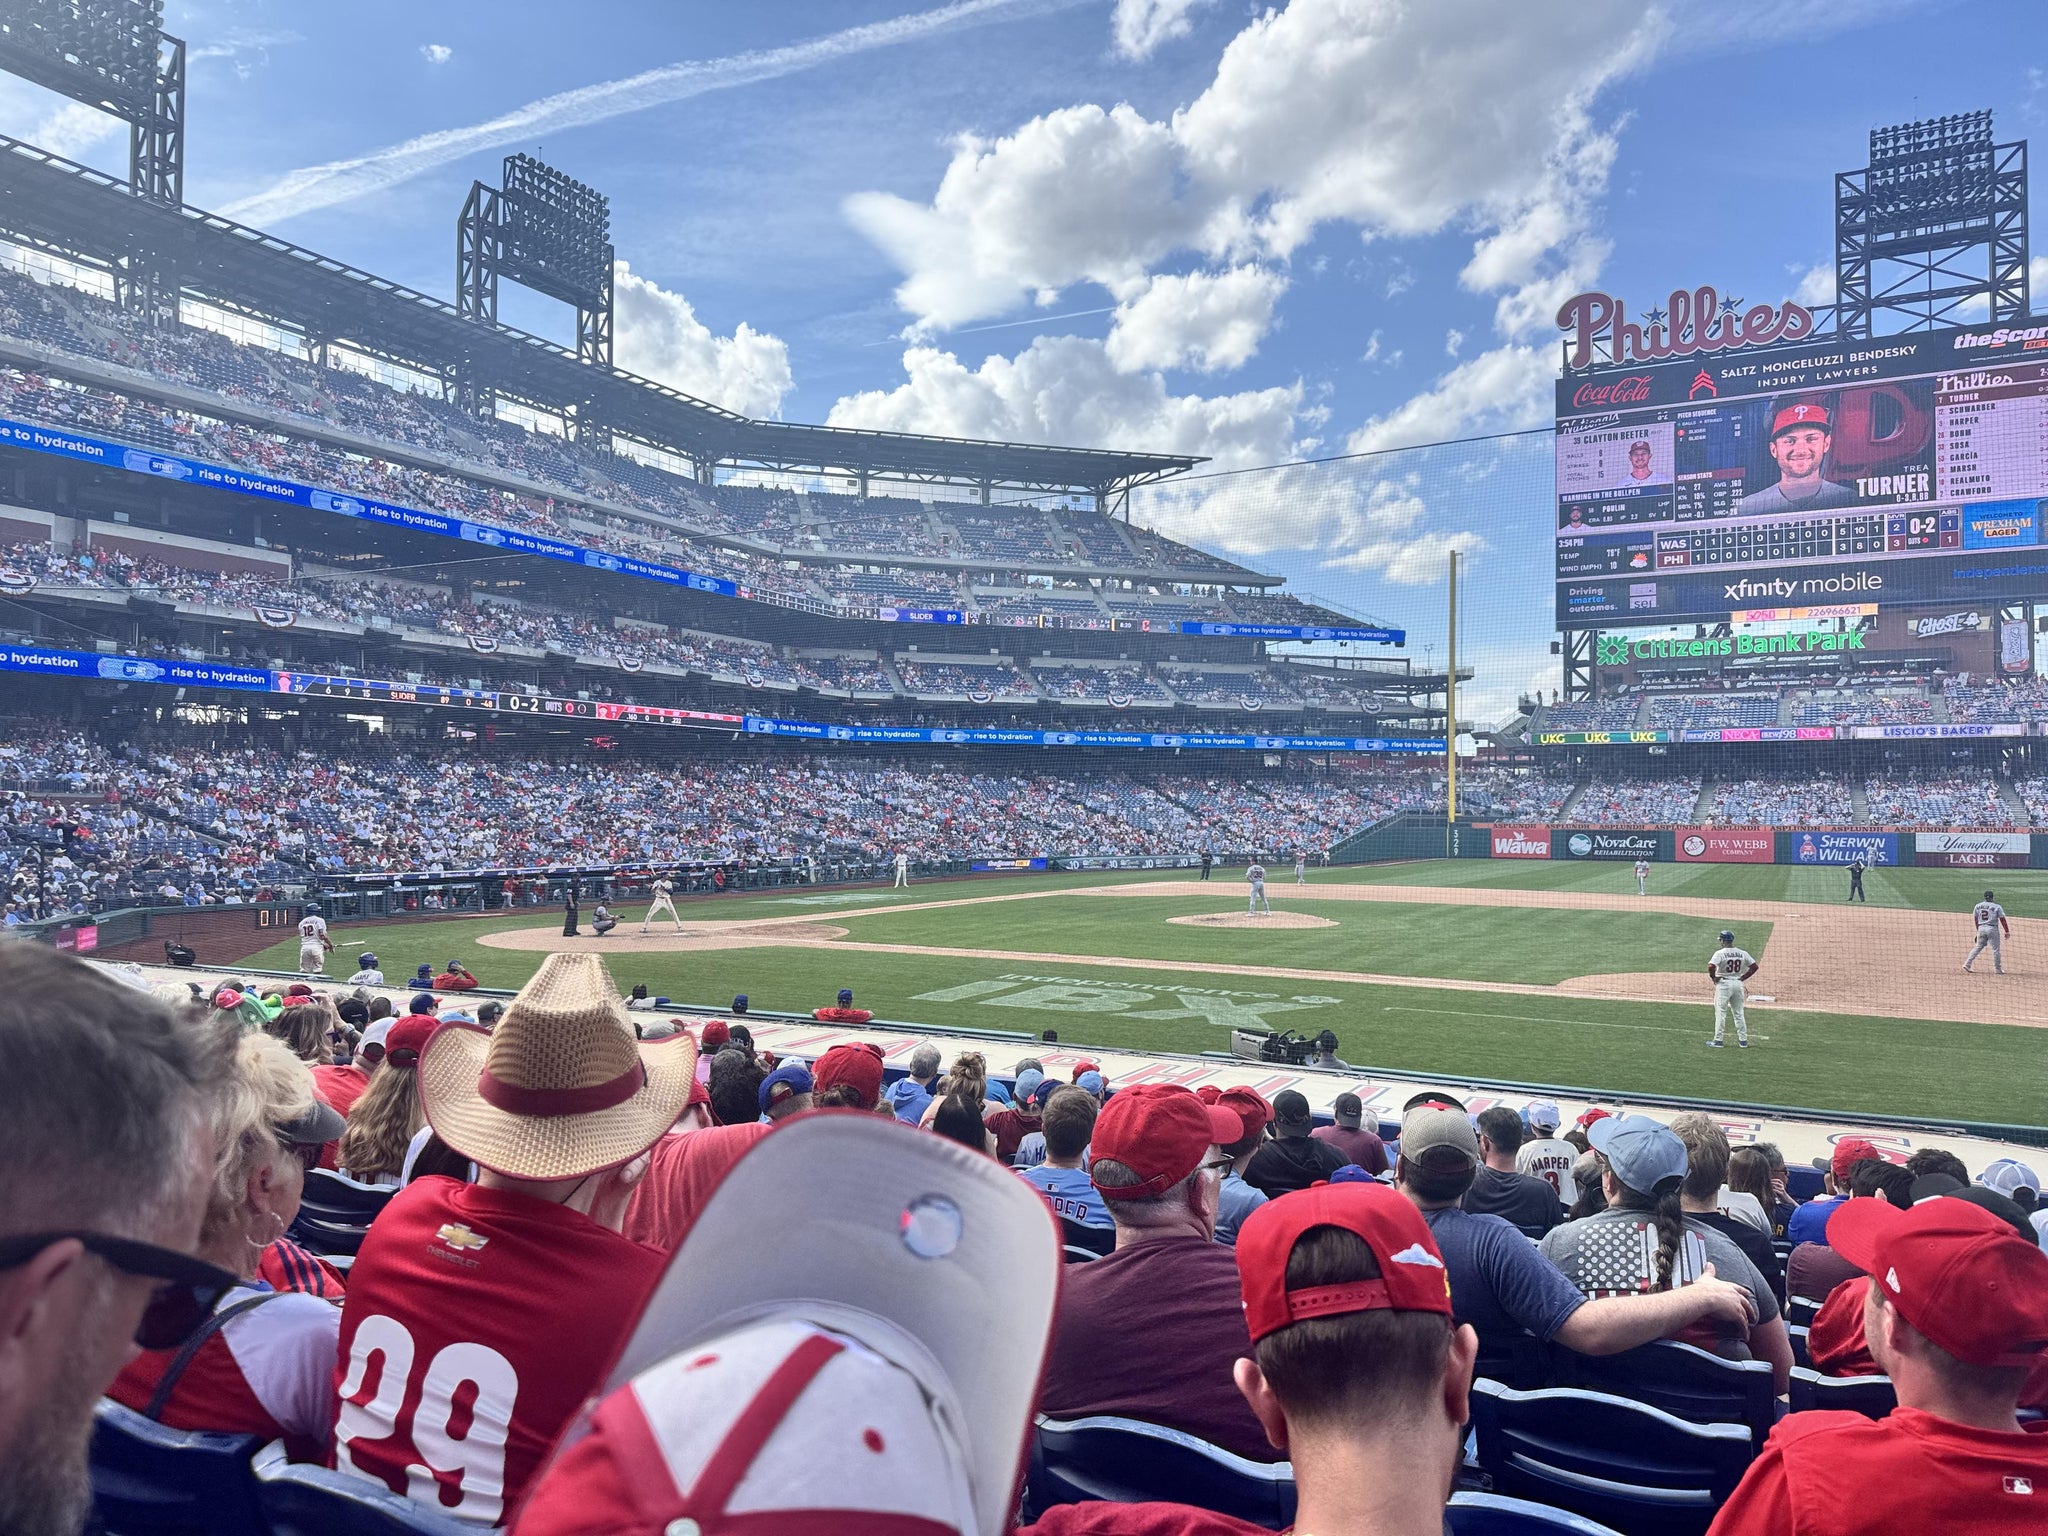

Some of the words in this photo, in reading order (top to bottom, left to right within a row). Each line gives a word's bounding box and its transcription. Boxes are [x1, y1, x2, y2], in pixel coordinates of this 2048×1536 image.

[1556, 286, 1813, 370] Phillies
[1954, 326, 2048, 349] theScor
[1721, 365, 1757, 379] SALTZ
[1763, 354, 1843, 373] MONGELUZZI
[1849, 345, 1917, 363] BENDESKY
[1758, 374, 1806, 388] INJURY
[1816, 365, 1878, 380] LAWYERS
[1936, 372, 2014, 391] Phillies
[1573, 375, 1654, 408] Coca-Cola
[1949, 393, 1979, 402] TURNER
[1949, 403, 1996, 414] SCHWARBER
[1949, 416, 1979, 426] HARPER
[1583, 432, 1619, 444] CLAYTON
[1620, 429, 1649, 440] BEETER
[1949, 429, 1971, 438] BOHM
[14, 428, 31, 441] to
[34, 432, 104, 457] hydration
[1949, 441, 1970, 450] SOSA
[1903, 464, 1929, 472] TREA
[1950, 464, 1977, 473] MARSH
[199, 468, 222, 482] rise
[224, 473, 237, 485] to
[240, 476, 295, 497] hydration
[1697, 471, 1713, 480] STATS
[1950, 474, 1991, 485] REALMUTO
[1856, 473, 1929, 497] TURNER
[1950, 486, 1992, 497] CRAWFORD
[1562, 493, 1592, 502] WARMING
[1614, 488, 1641, 498] BULLPEN
[1602, 504, 1625, 512] POULIN
[370, 505, 389, 517] rise
[390, 510, 401, 520] to
[403, 512, 448, 530] hydration
[1971, 517, 2032, 531] WREXHAM
[1910, 517, 1936, 534] 0-2
[1660, 539, 1687, 550] WAS
[1854, 526, 1865, 534] 10
[1986, 529, 2018, 537] LAGER
[509, 536, 525, 546] rise
[526, 539, 535, 549] to
[536, 542, 574, 557] hydration
[1663, 555, 1684, 565] PHI
[1840, 543, 1846, 551] 3
[1856, 542, 1863, 550] 8
[1893, 539, 1900, 547] 3
[625, 562, 639, 571] rise
[639, 565, 647, 573] to
[648, 567, 680, 580] hydration
[1580, 563, 1602, 571] (MPH)
[1610, 561, 1617, 570] 10
[1570, 587, 1603, 596] Driving
[1724, 577, 1798, 601] xfinity
[1803, 571, 1882, 593] mobile
[1569, 595, 1606, 604] smarter
[1569, 604, 1618, 613] outcomes.
[909, 612, 933, 620] SLIDER
[946, 614, 957, 622] 89
[1918, 612, 1966, 635] GHOST
[1634, 637, 1731, 659] Citizens
[1737, 631, 1802, 654] Bank
[1807, 628, 1865, 651] Park
[11, 652, 78, 668] hydration
[171, 667, 193, 678] rise
[195, 670, 209, 680] to
[211, 671, 265, 686] hydration
[362, 689, 370, 697] 15
[390, 691, 416, 701] SLIDER
[440, 695, 449, 704] 89
[510, 696, 538, 711] 0-2
[545, 702, 562, 712] OUTS
[883, 731, 920, 739] hydration
[1540, 733, 1566, 744] UKG
[1584, 732, 1610, 743] UKG
[1630, 731, 1656, 742] UKG
[1724, 730, 1758, 740] NECA
[1800, 729, 1834, 738] NECA
[1884, 726, 1936, 736] LISCIO'S
[1941, 726, 1993, 735] BAKERY
[1495, 838, 1548, 854] Wawa
[1593, 835, 1656, 848] NovaCare
[1710, 840, 1729, 849] F.W.
[1733, 840, 1768, 849] WEBB
[1937, 835, 2008, 852] Yuengling
[1950, 854, 1995, 864] LAGER
[1981, 909, 1989, 921] 2
[1726, 959, 1742, 973] 38
[997, 973, 1279, 1000] Independence
[1530, 1156, 1570, 1172] HARPER
[335, 1314, 518, 1529] 29
